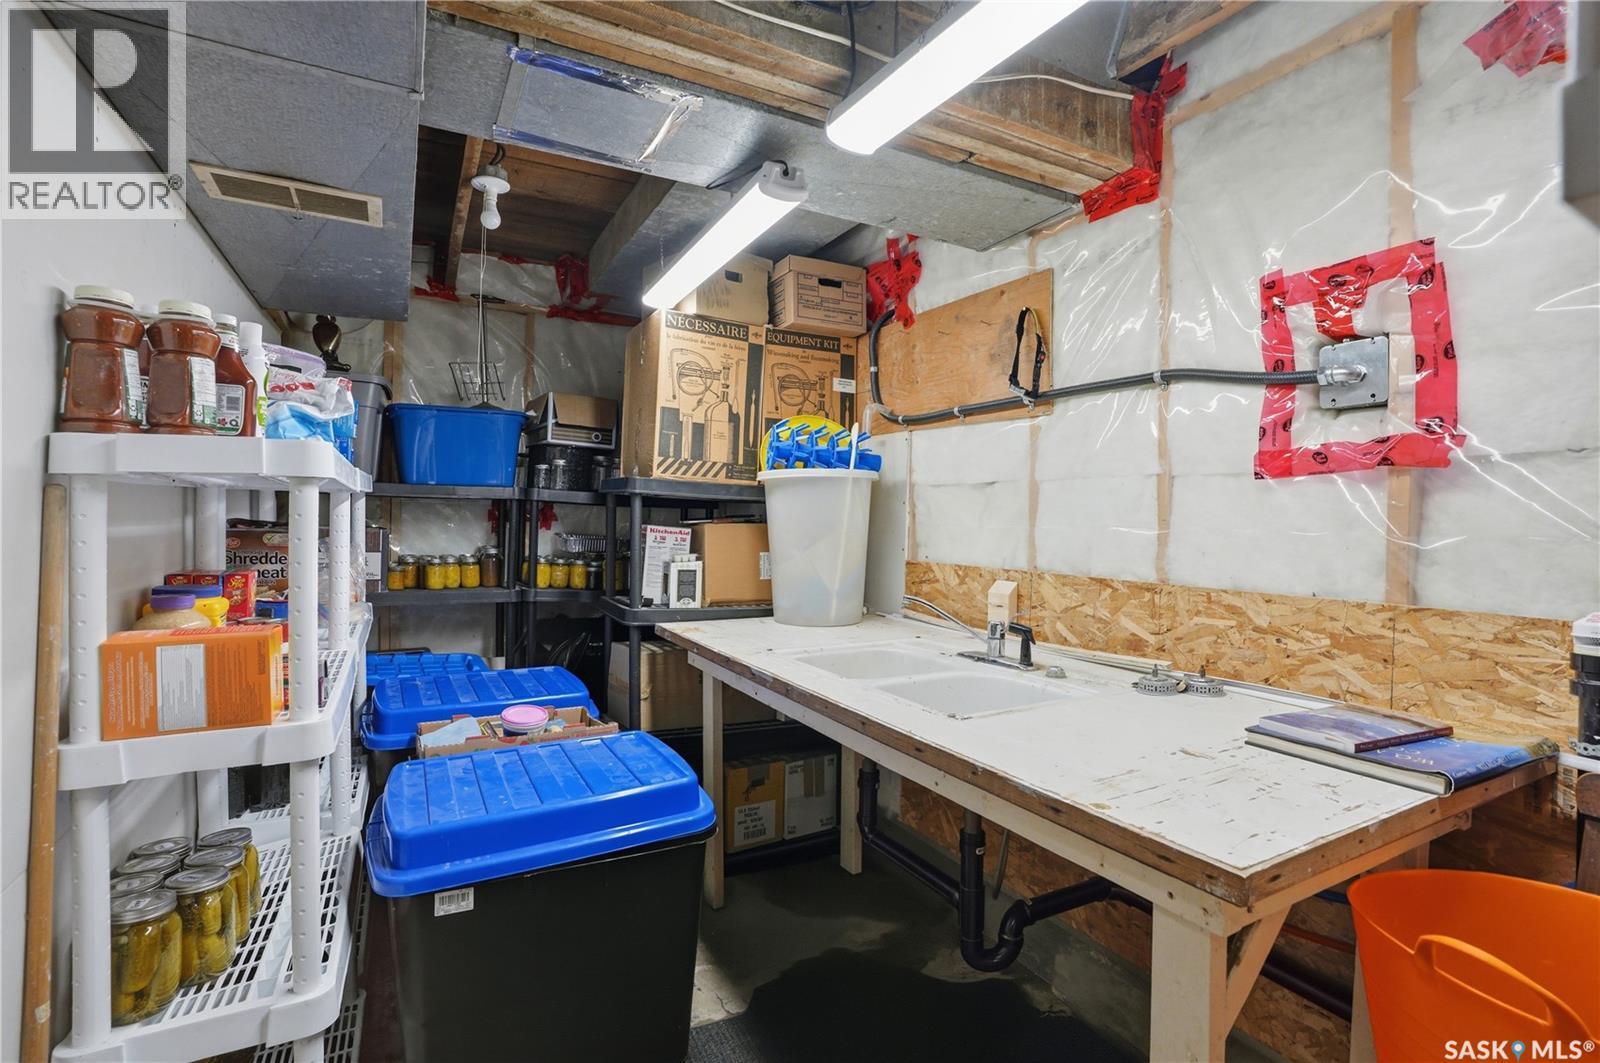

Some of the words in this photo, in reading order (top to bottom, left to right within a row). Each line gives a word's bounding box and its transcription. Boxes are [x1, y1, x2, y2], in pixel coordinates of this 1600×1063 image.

[666, 313, 748, 339] NÉCESSAIRE
[767, 331, 822, 348] EQUIPMENT
[823, 339, 840, 350] KIT
[649, 527, 690, 536] KitchenAid
[226, 548, 288, 565] Shredde
